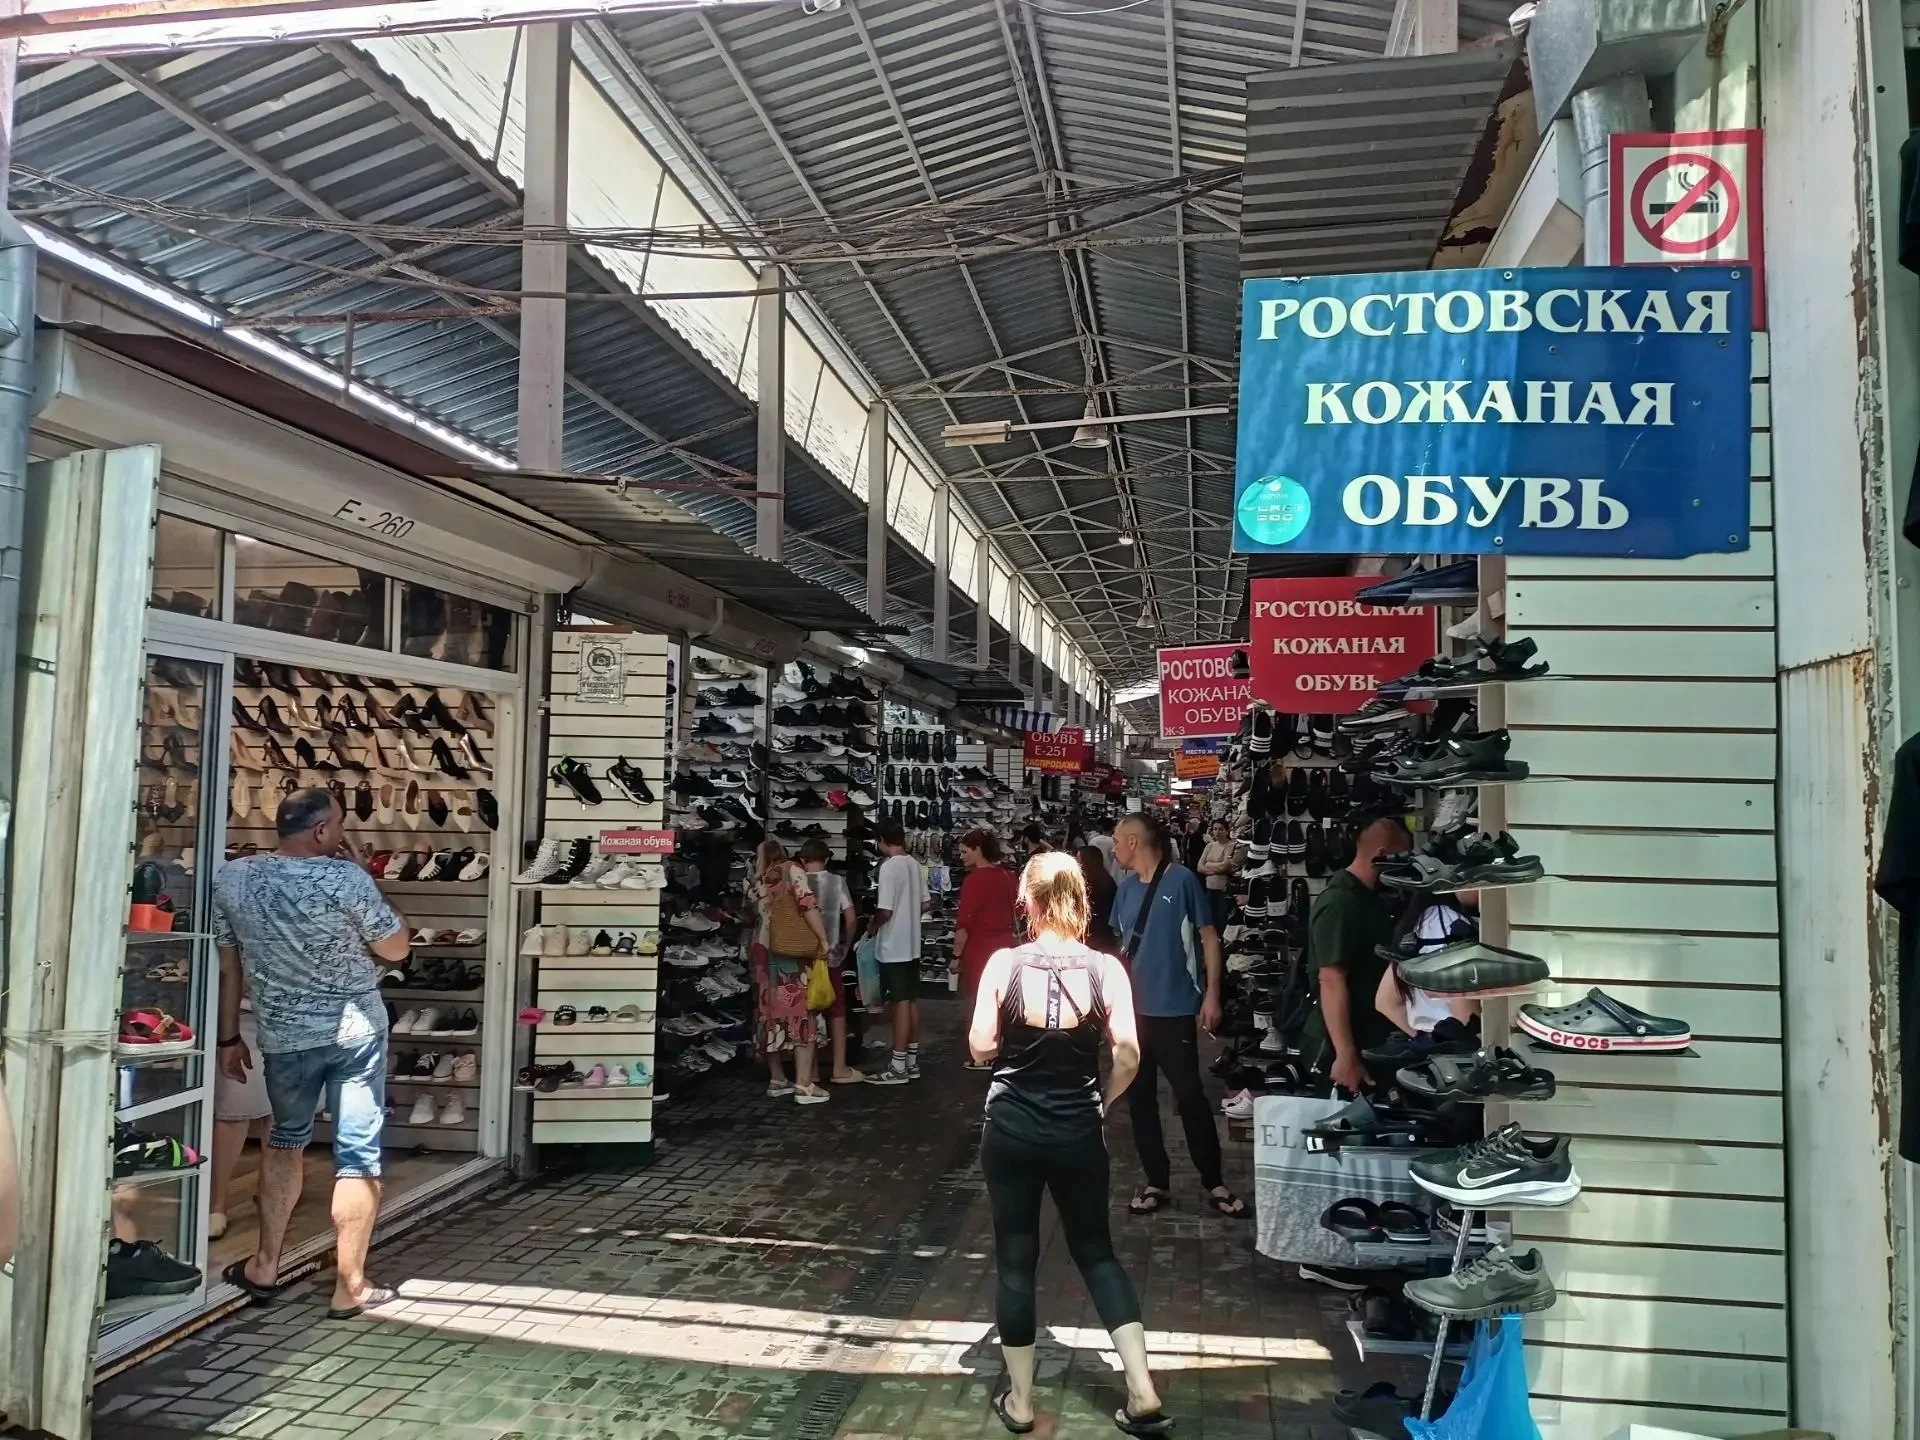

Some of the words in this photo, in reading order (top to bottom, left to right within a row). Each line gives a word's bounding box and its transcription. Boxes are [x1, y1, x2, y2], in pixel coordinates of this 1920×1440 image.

[1257, 289, 1732, 341] РОСТОВСКАЯ
[1304, 380, 1676, 426] КОЖАНАЯ
[1342, 474, 1630, 530] ОБУВЬ
[1273, 636, 1406, 655] КОЖАНАЯ
[1160, 657, 1234, 681] РОСТОВС
[1168, 685, 1251, 704] КОЖАНА
[1031, 732, 1078, 745] ОБУВЬ
[1164, 726, 1186, 736] Ж-3
[1034, 745, 1067, 757] Е-251
[1025, 759, 1081, 770] РАСПРОДАЖА
[601, 836, 641, 846] Кожаная
[643, 835, 673, 848] обувь
[1048, 997, 1058, 1029] NIKE
[1550, 1031, 1610, 1049] crocs
[1260, 1124, 1298, 1149] EL
